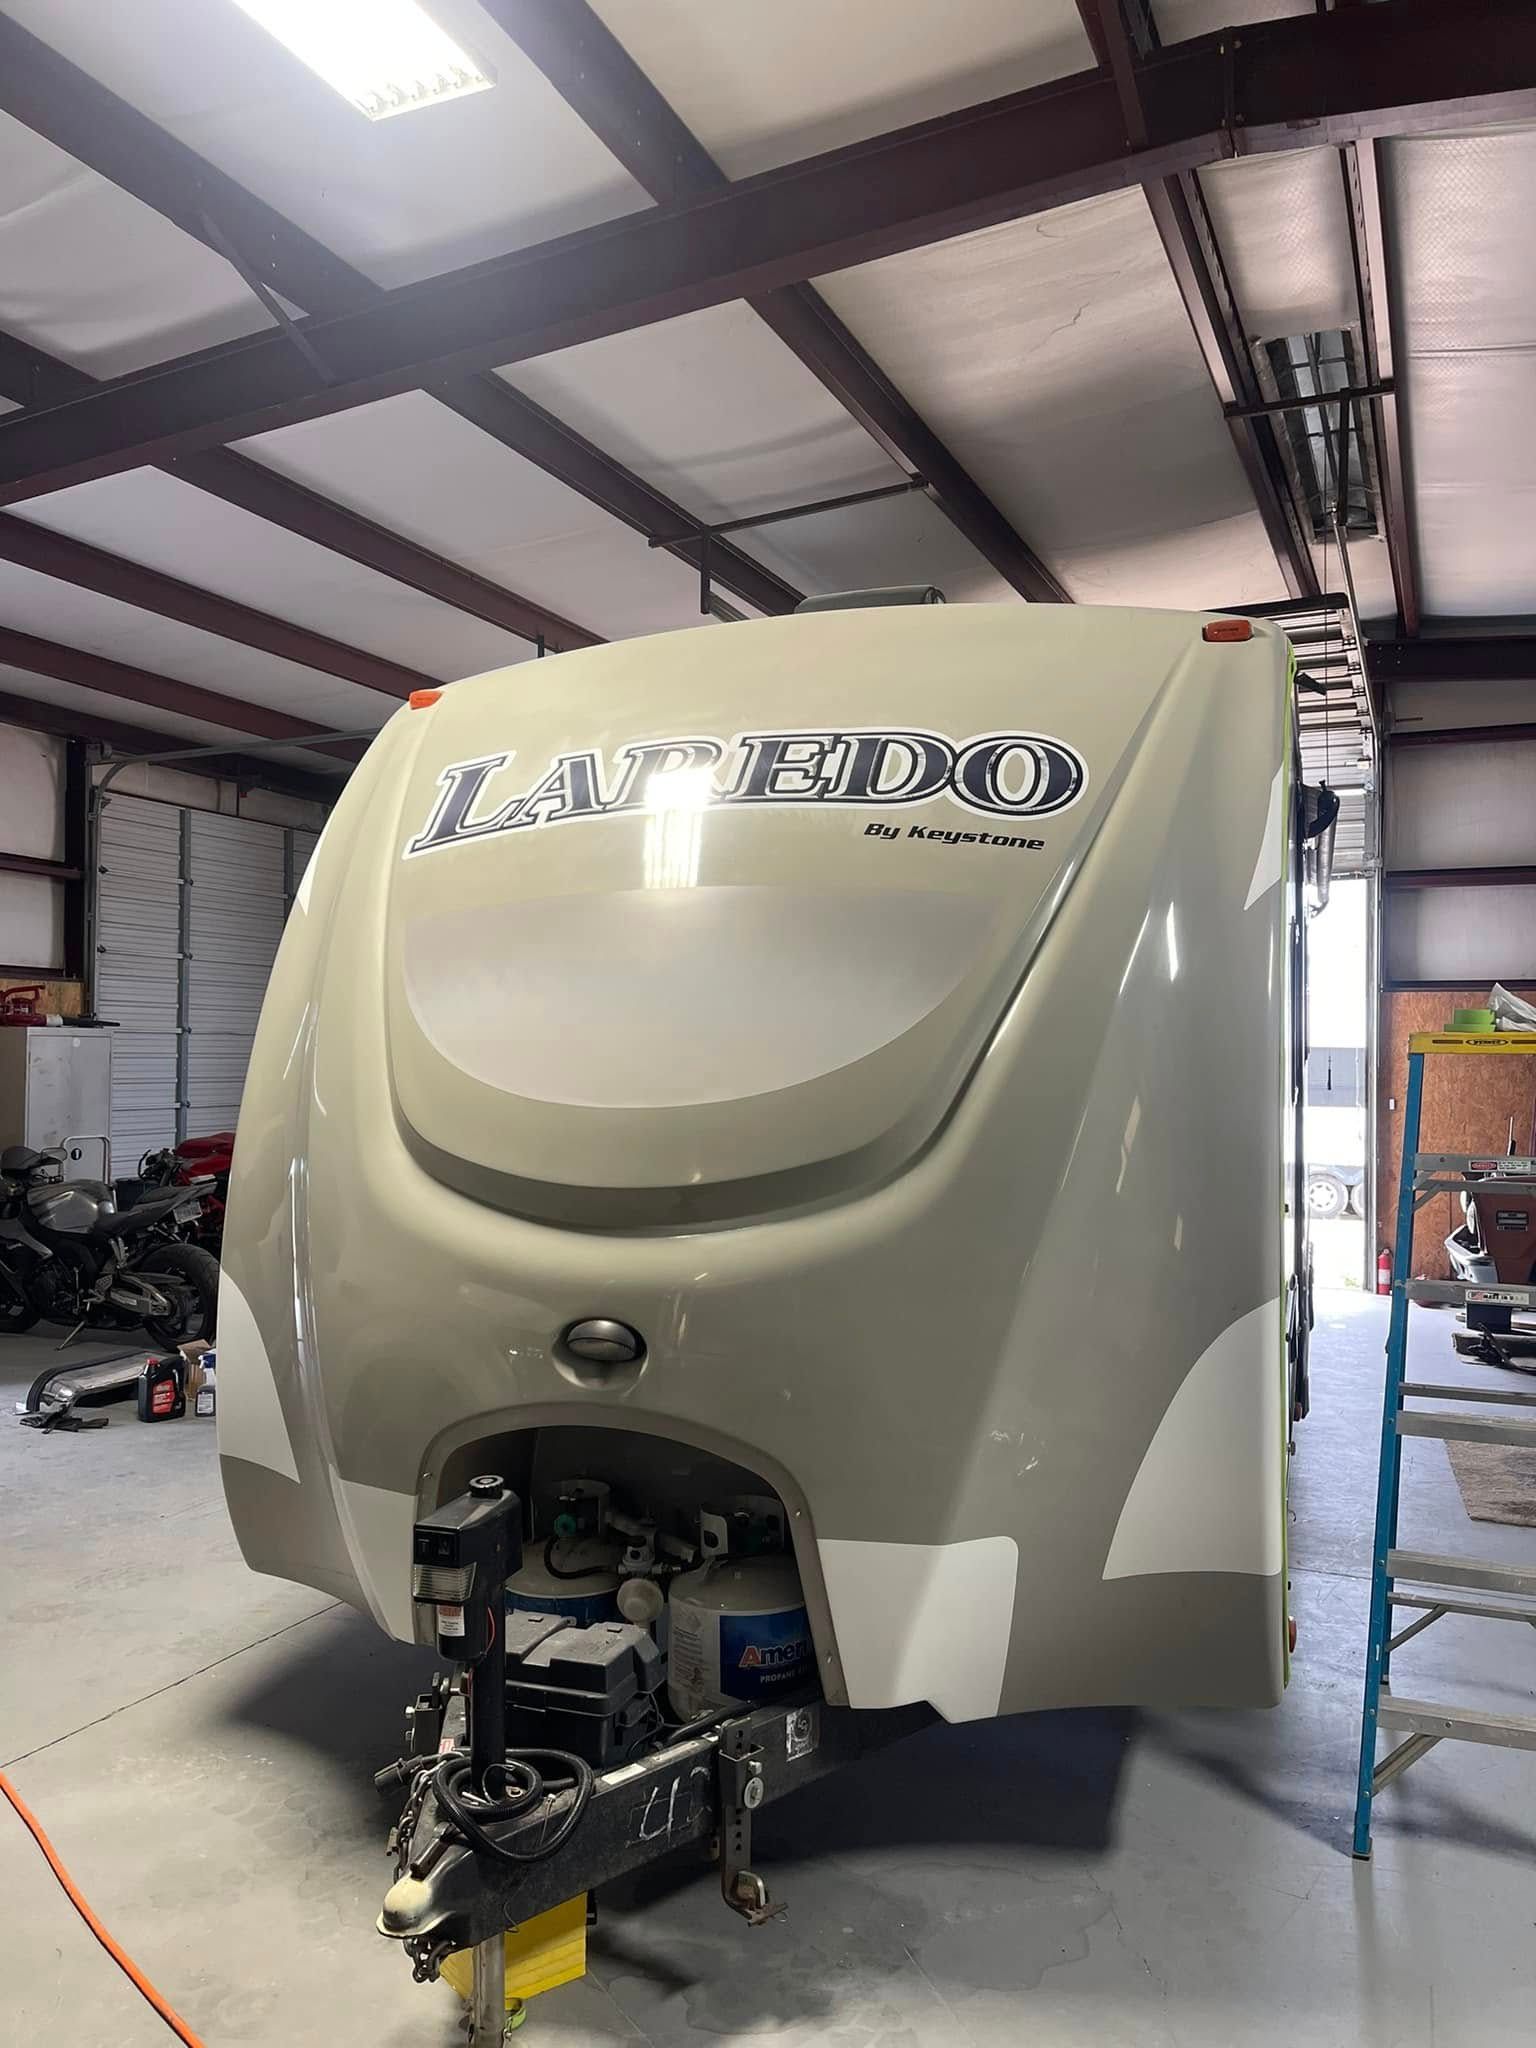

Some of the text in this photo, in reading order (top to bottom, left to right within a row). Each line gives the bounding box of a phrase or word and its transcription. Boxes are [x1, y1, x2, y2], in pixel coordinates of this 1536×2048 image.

[404, 729, 1087, 856] LAREDO
[864, 823, 1045, 850] By Keystone
